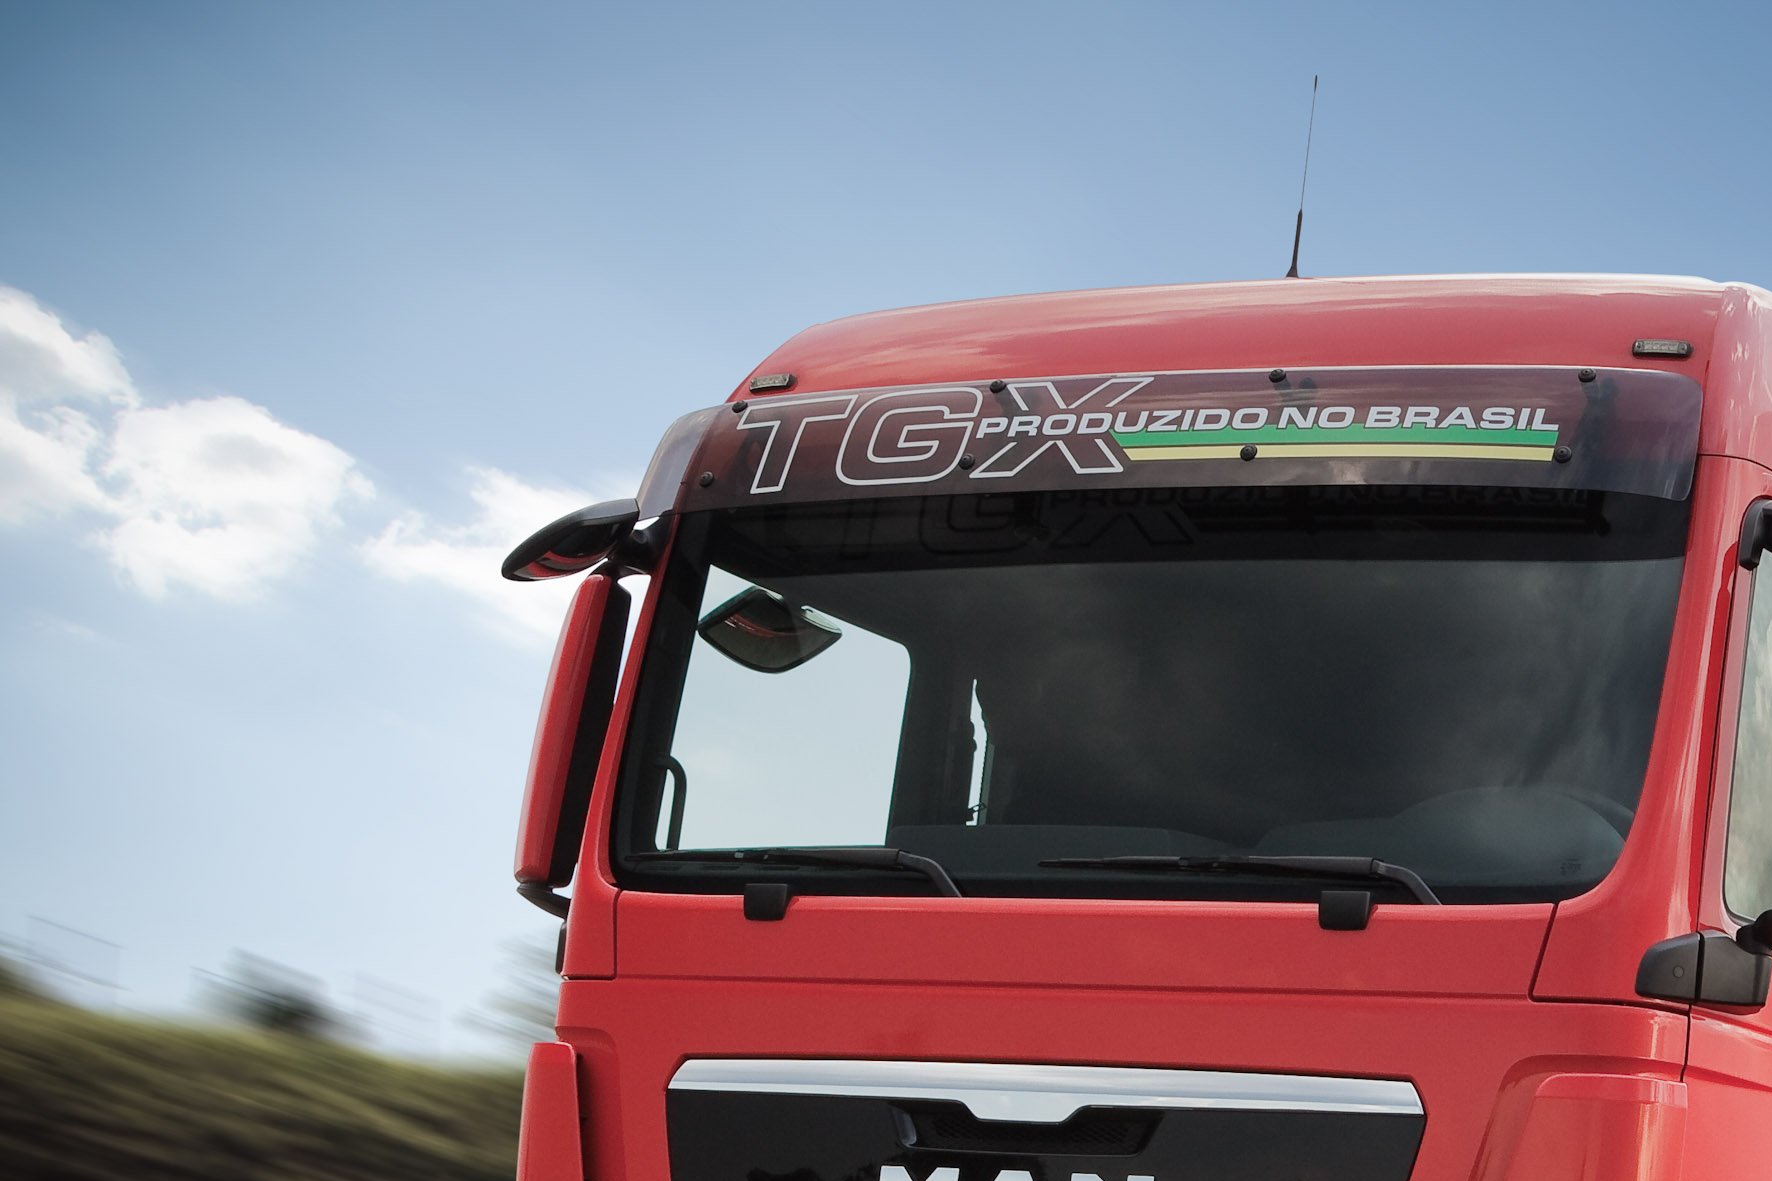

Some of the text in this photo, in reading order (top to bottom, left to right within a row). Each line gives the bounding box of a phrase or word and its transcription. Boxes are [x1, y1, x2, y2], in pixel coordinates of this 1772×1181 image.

[737, 376, 1154, 494] TGX
[975, 406, 1559, 438] PRODUZIDO NO BRASIL
